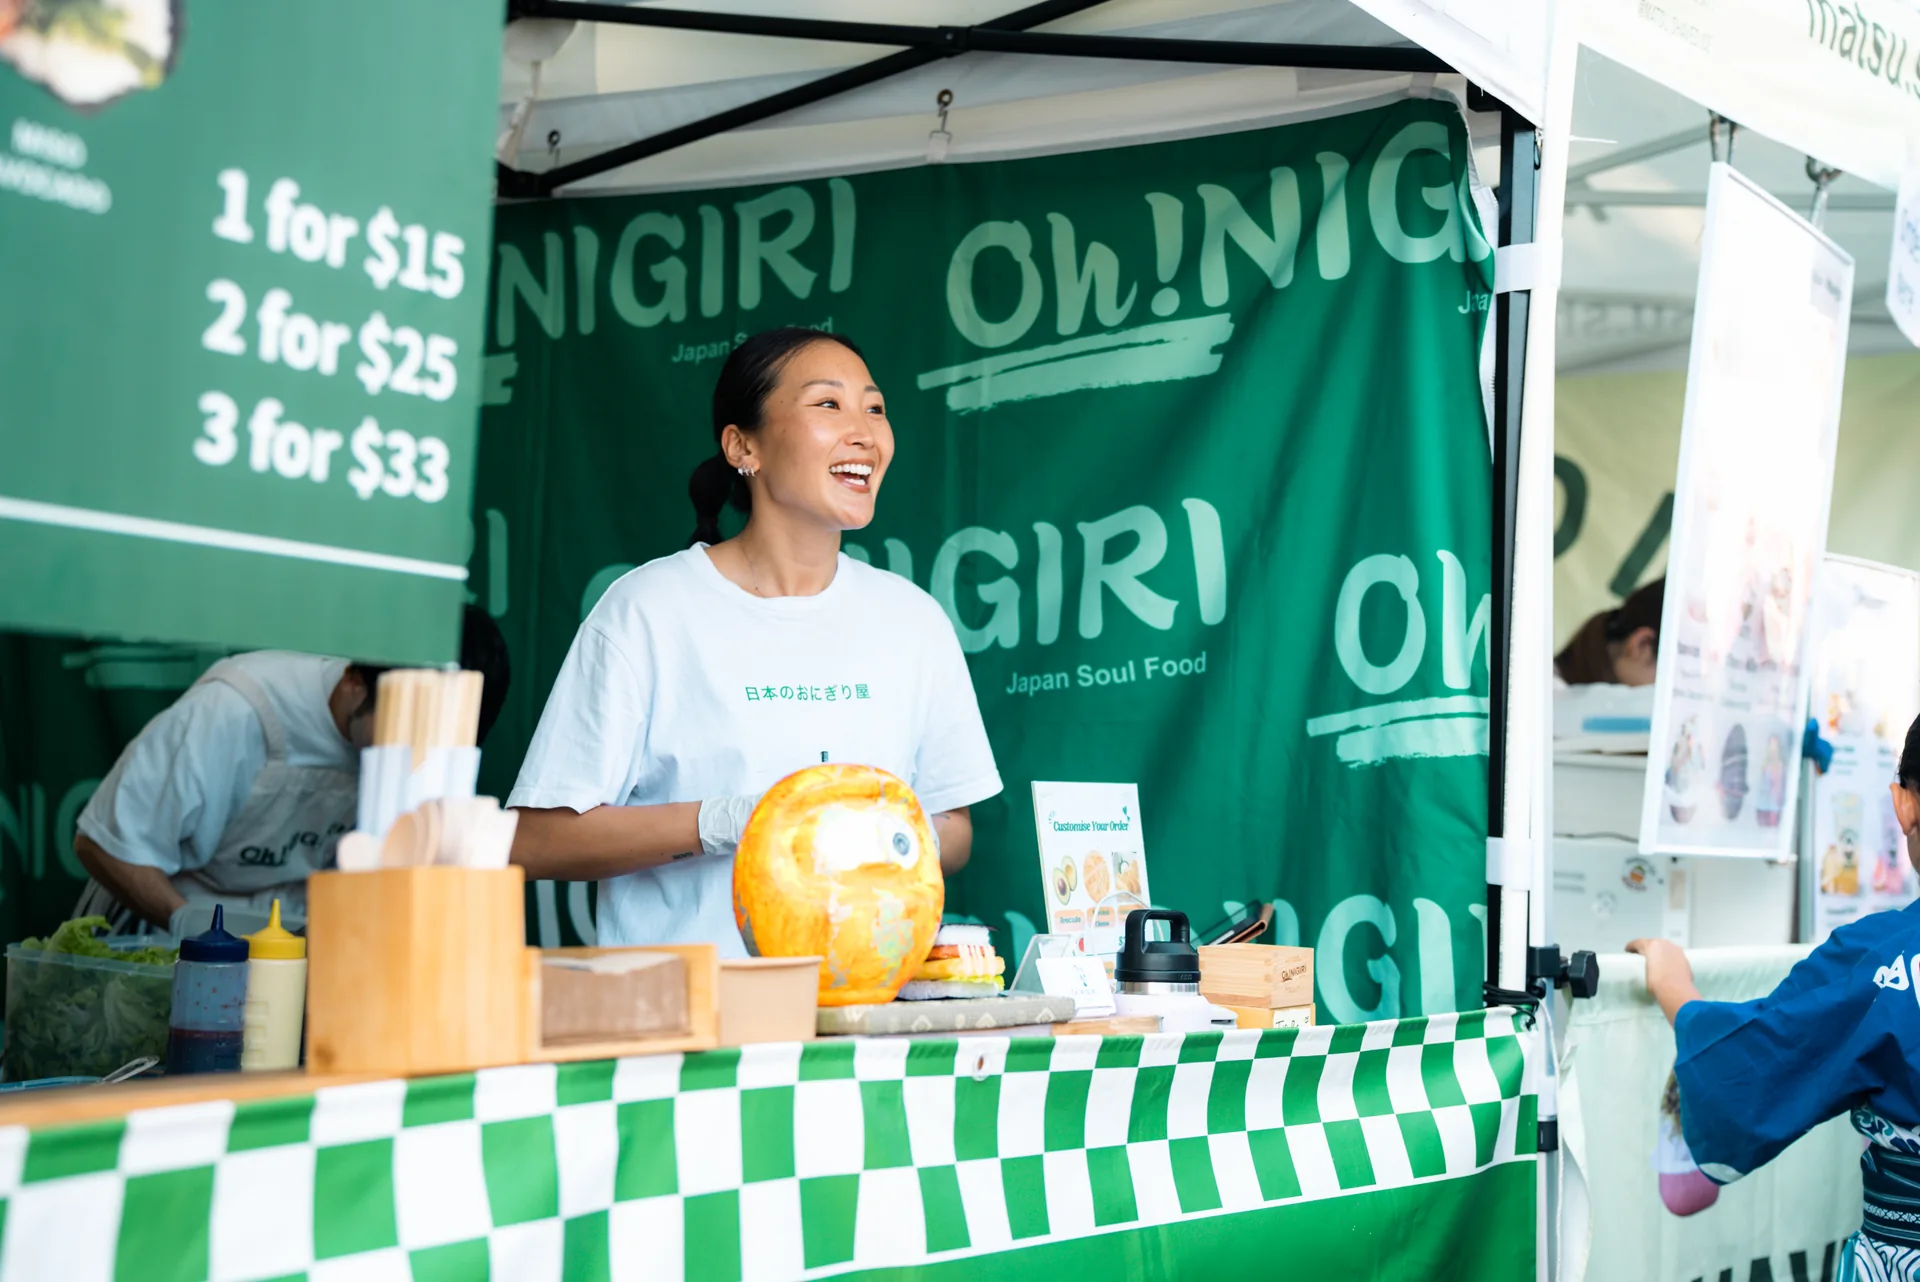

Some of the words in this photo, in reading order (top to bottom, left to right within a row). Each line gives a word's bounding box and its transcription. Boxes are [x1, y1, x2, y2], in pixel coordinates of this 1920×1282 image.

[1806, 0, 1920, 101] matsu.
[213, 168, 253, 243] 1
[265, 177, 359, 268] for
[364, 205, 465, 299] $15
[201, 279, 247, 355] 2
[257, 288, 351, 375] for
[356, 311, 458, 402] $25
[193, 391, 239, 465] 3
[247, 397, 343, 483] for
[348, 416, 450, 502] $33
[745, 683, 871, 701] 日本のおにぎり屋
[1006, 672, 1069, 697] Japan
[1076, 660, 1136, 687] Soul
[1143, 650, 1207, 680] Food
[1053, 820, 1091, 832] Customise
[1092, 821, 1110, 832] Your
[1109, 820, 1129, 831] Order
